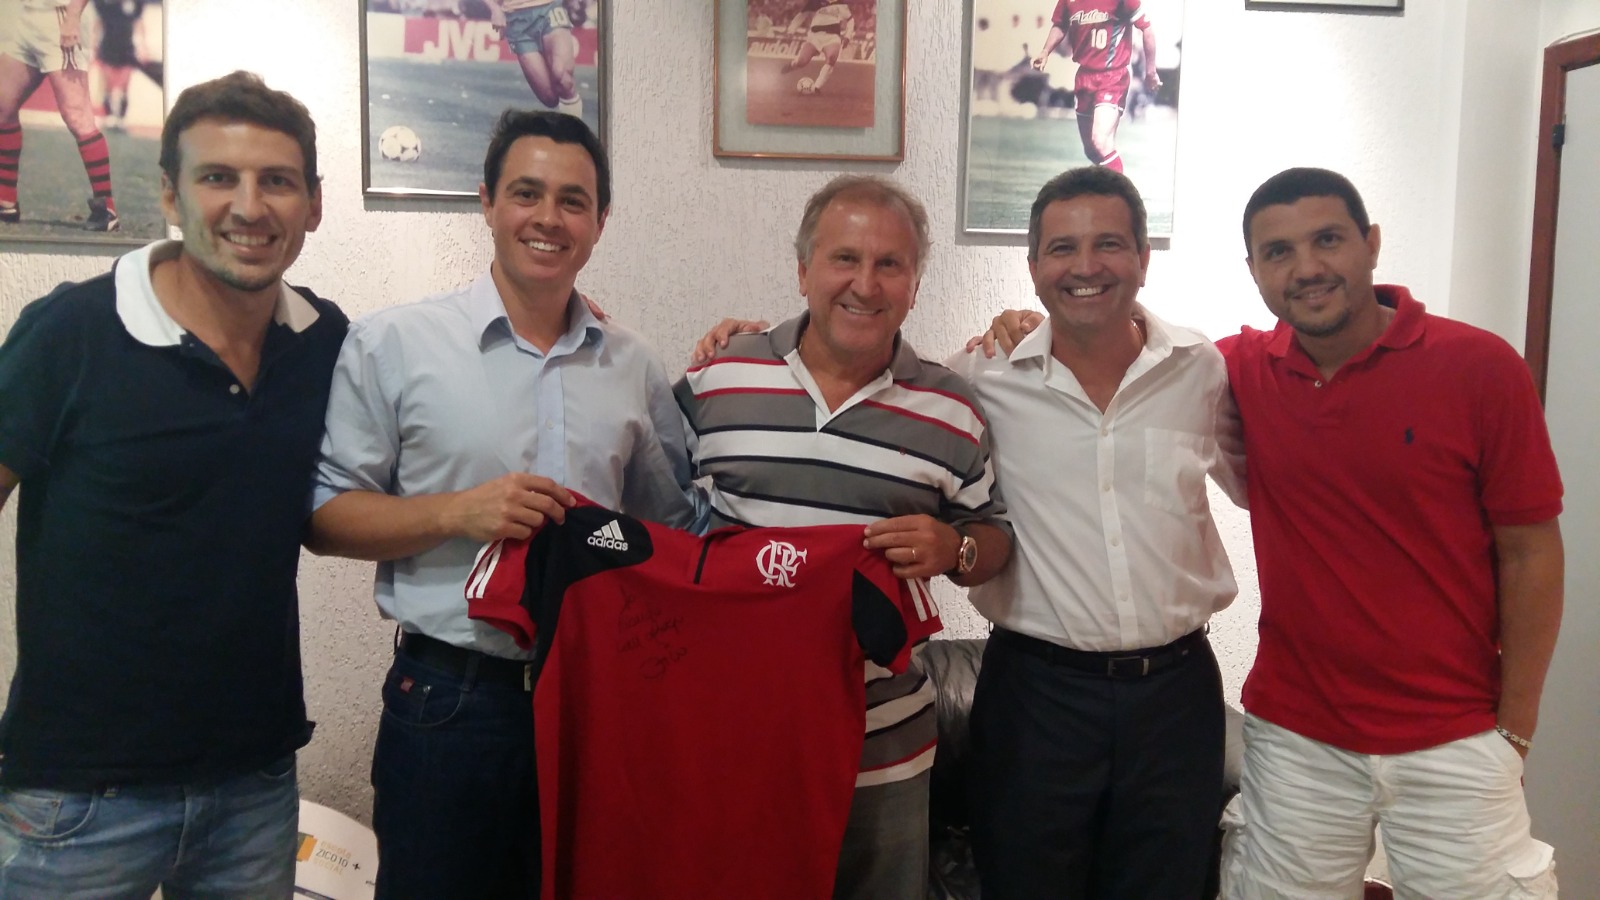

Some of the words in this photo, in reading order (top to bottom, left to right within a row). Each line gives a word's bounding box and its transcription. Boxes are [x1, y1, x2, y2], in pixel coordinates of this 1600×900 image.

[550, 7, 568, 27] 10
[422, 19, 500, 63] JVC
[1090, 27, 1108, 50] 10
[586, 535, 629, 552] adidas
